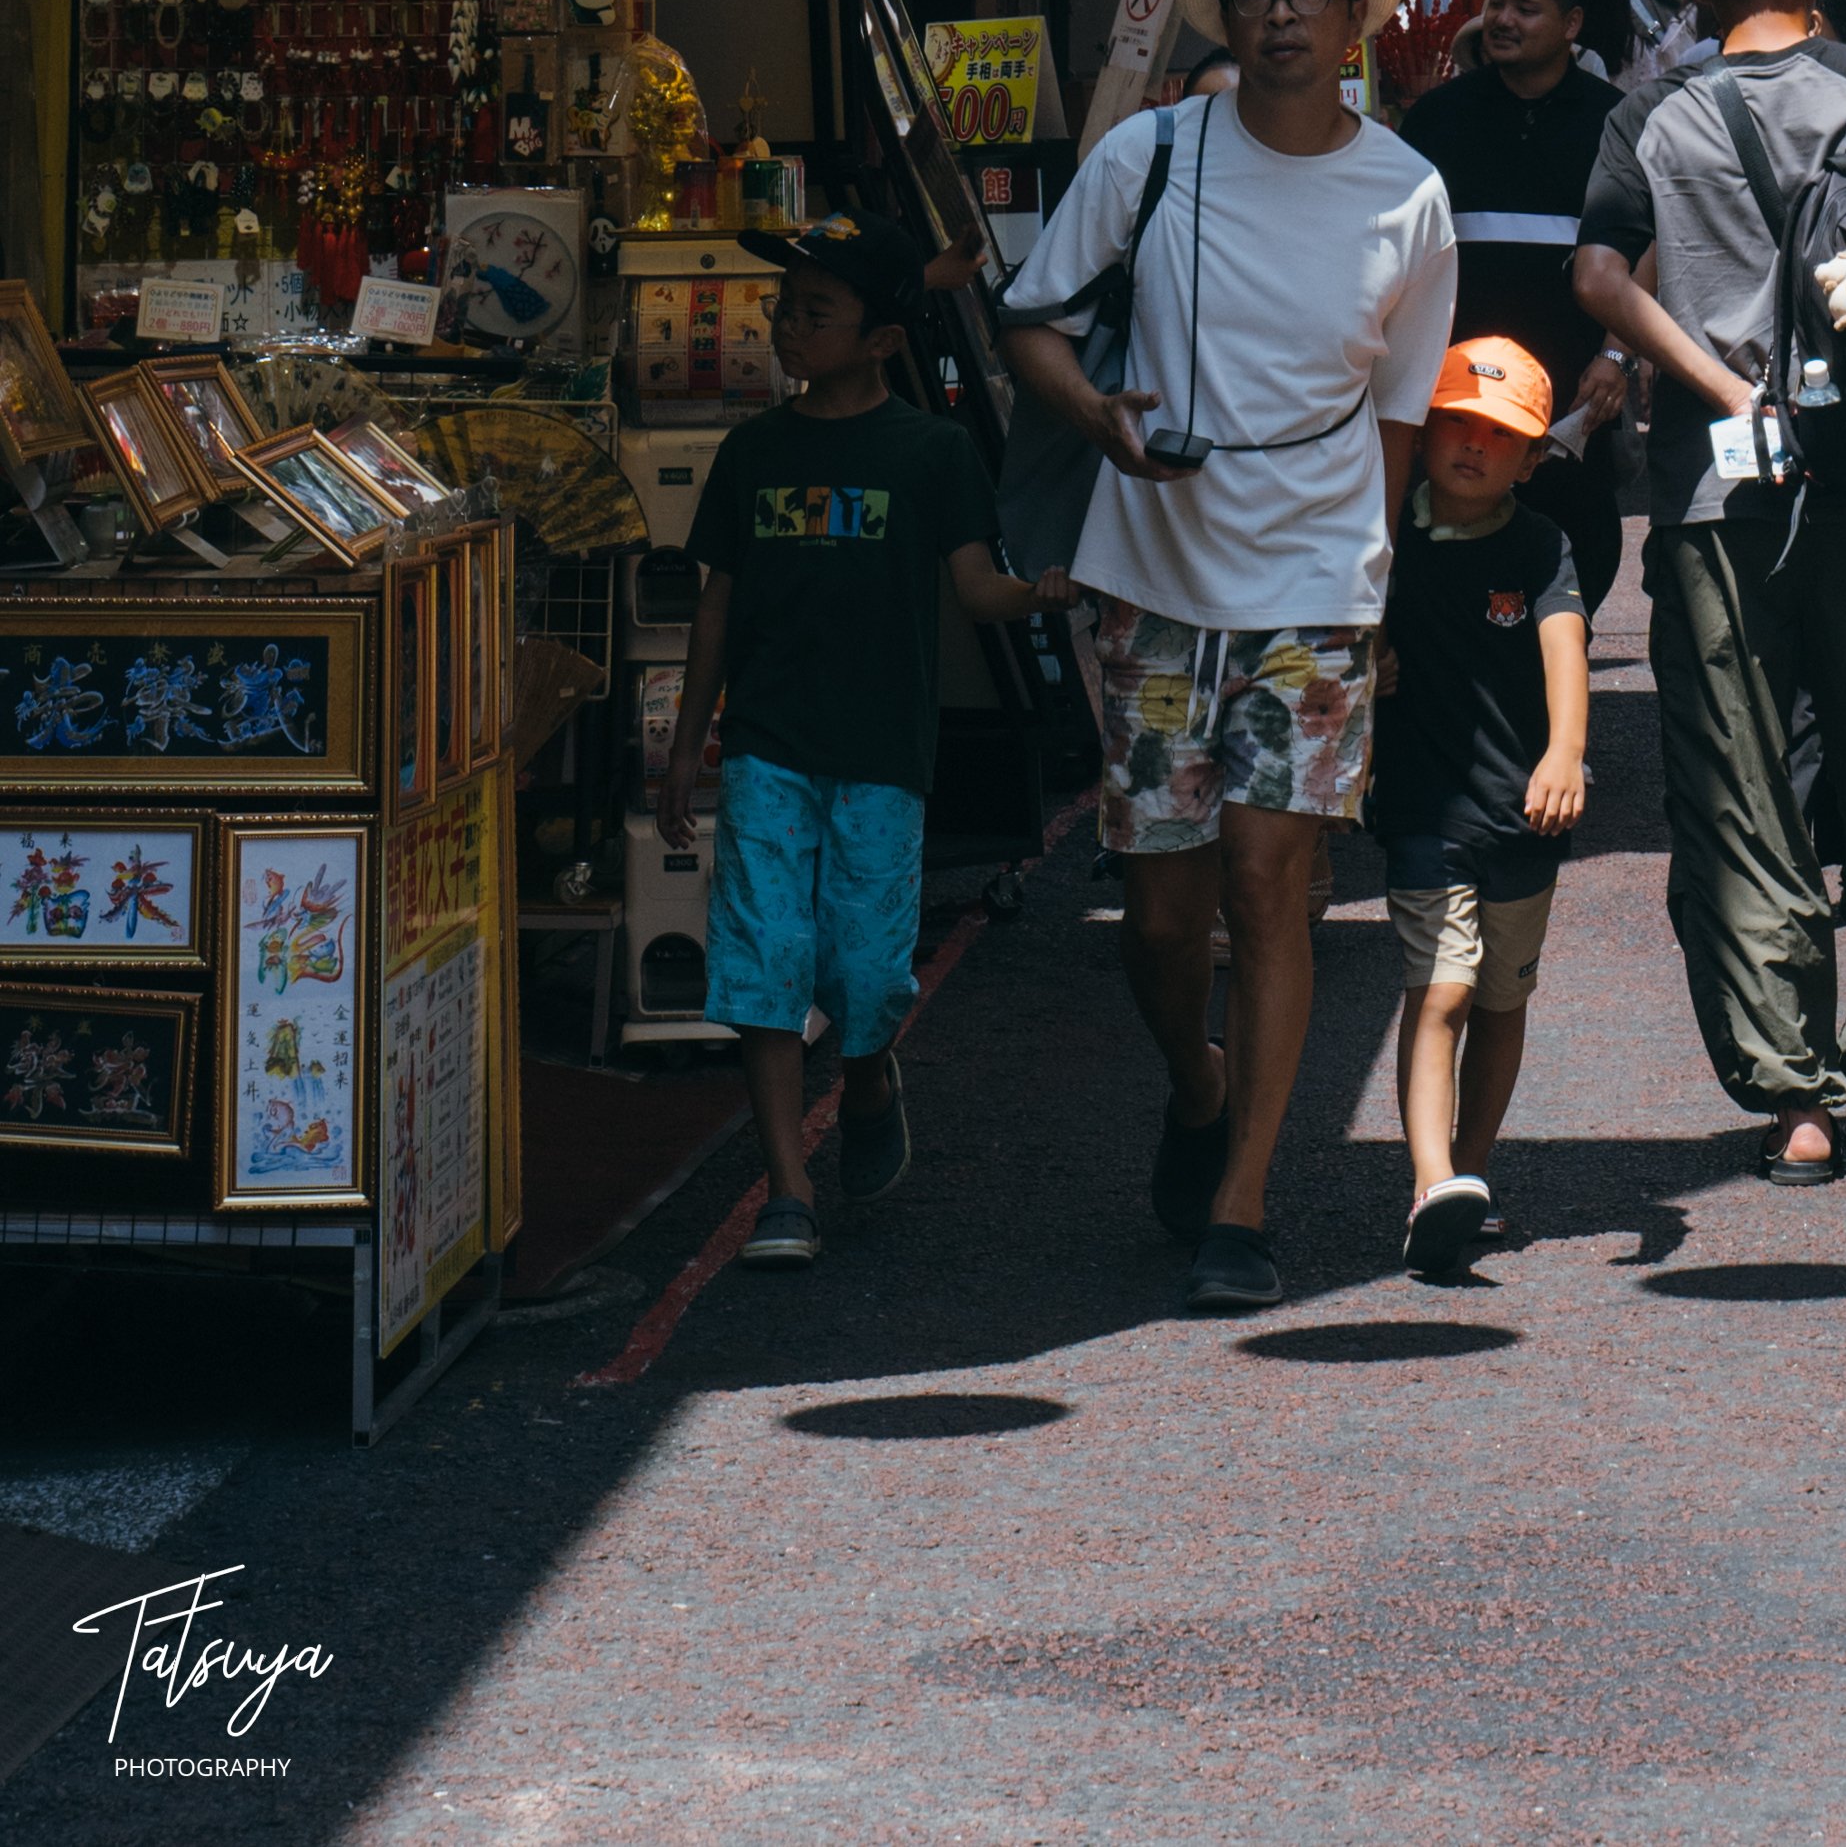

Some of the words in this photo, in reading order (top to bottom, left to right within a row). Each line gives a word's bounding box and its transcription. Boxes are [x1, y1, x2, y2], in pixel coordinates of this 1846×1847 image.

[950, 29, 1039, 60] キャンペーン
[982, 166, 1012, 206] 館
